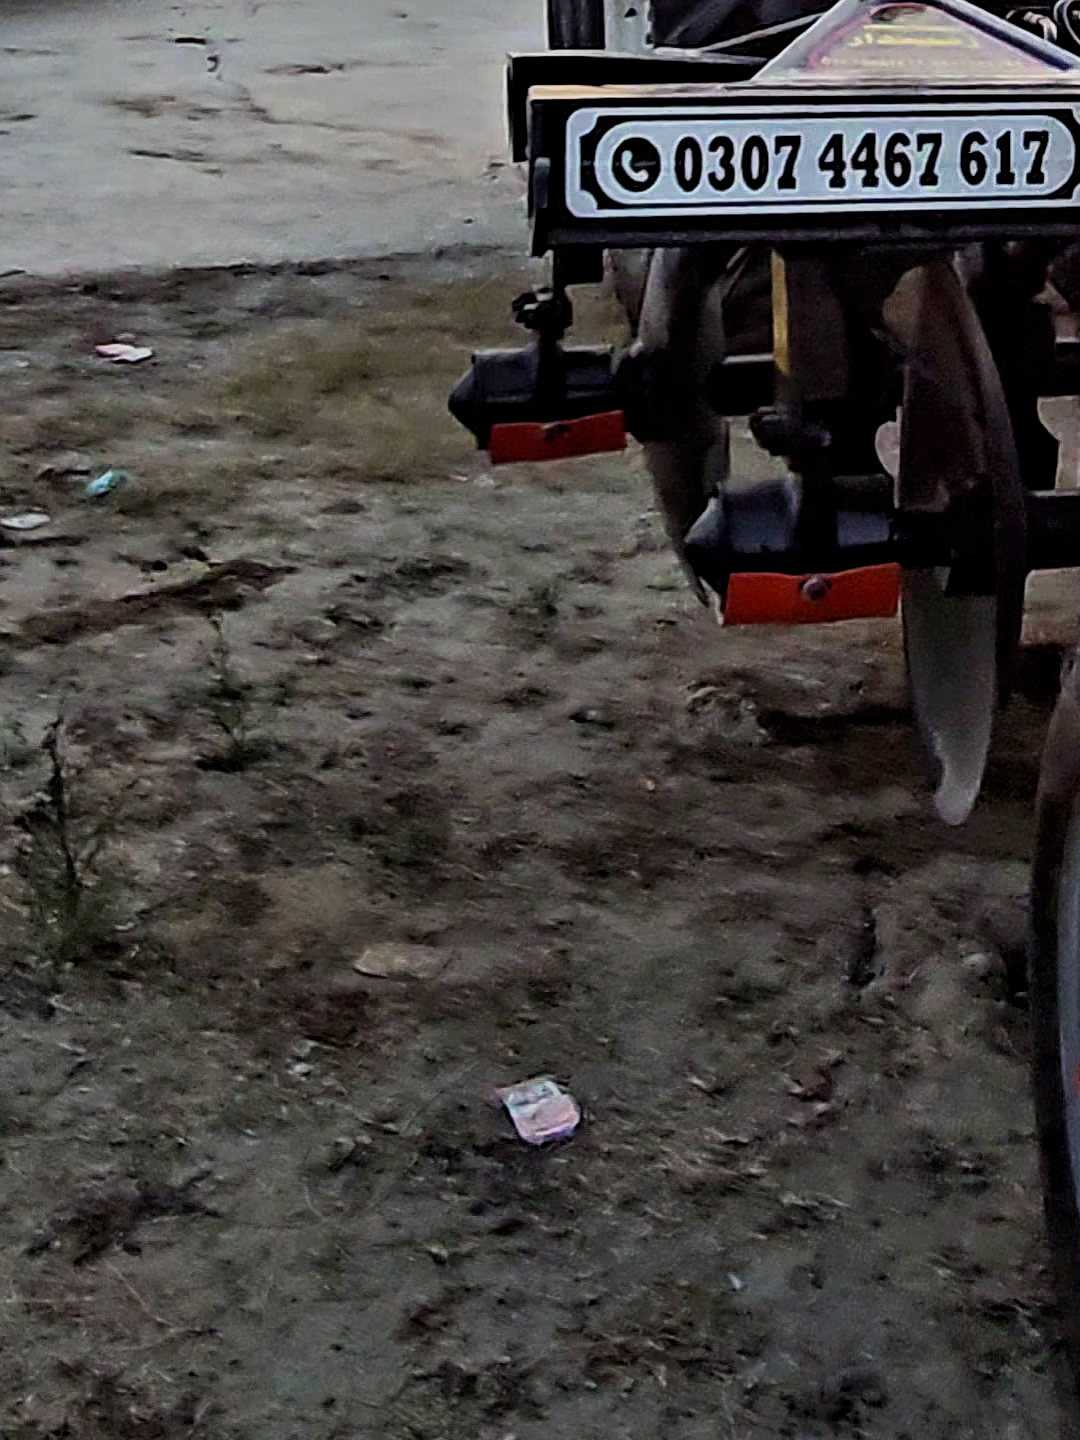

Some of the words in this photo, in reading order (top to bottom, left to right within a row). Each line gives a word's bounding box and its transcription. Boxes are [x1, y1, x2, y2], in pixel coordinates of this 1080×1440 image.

[674, 136, 802, 192] 0307
[818, 131, 943, 189] 4467
[959, 129, 1050, 186] 617
